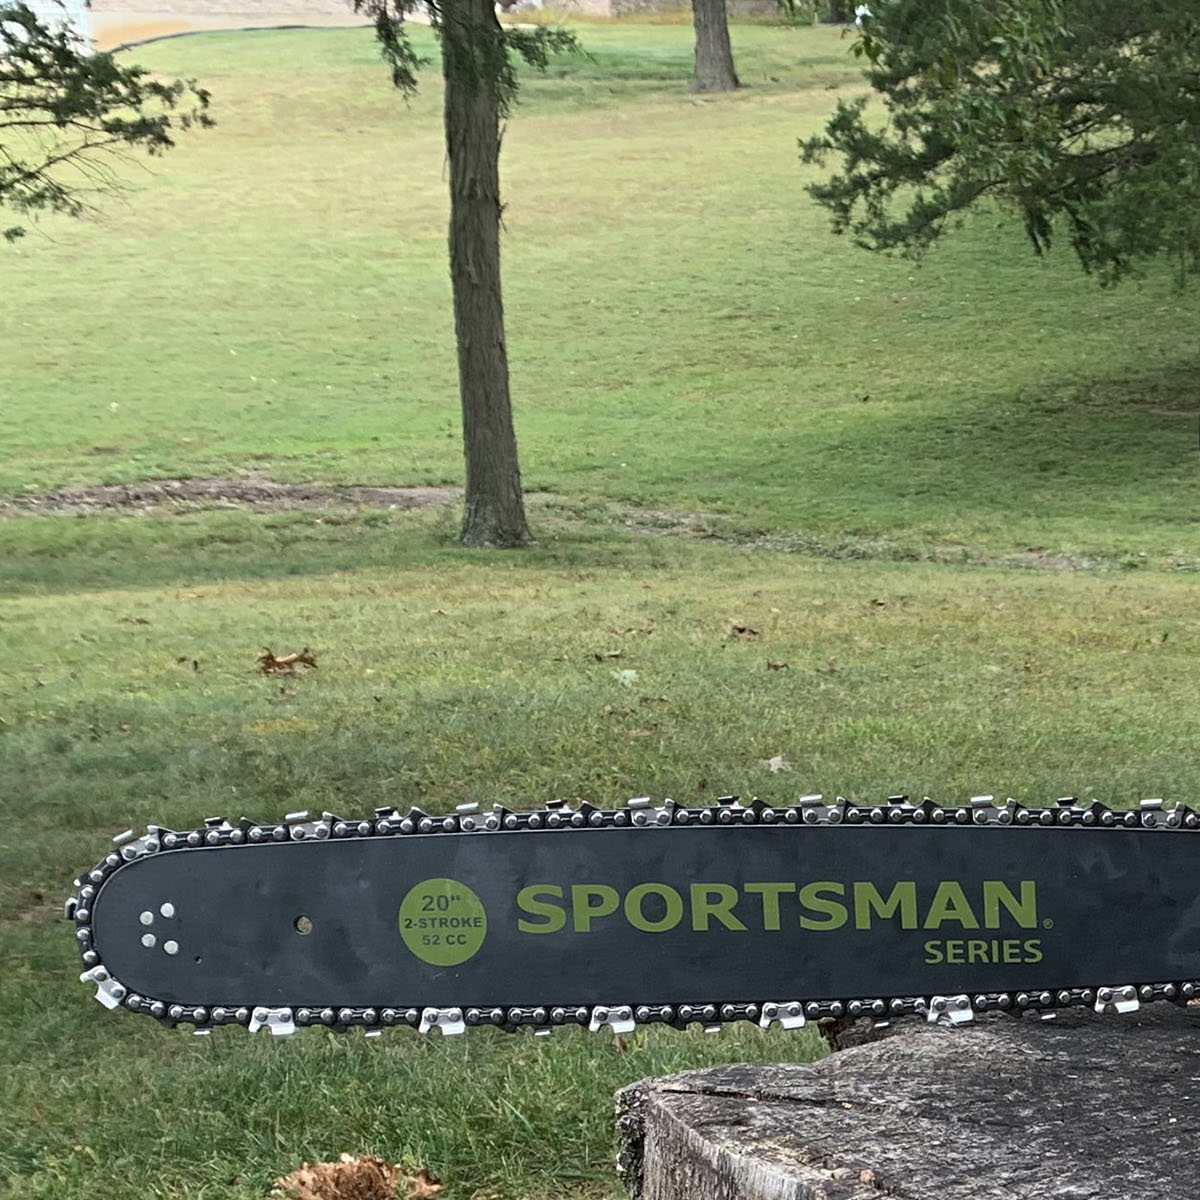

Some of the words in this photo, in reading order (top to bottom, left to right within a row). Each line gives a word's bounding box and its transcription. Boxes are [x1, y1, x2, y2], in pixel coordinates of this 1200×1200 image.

[516, 880, 1038, 934] SPORTSMAN
[404, 916, 483, 930] 2-STROKE
[422, 934, 441, 946] 52
[446, 934, 467, 946] CC
[924, 939, 1043, 964] SERIES
